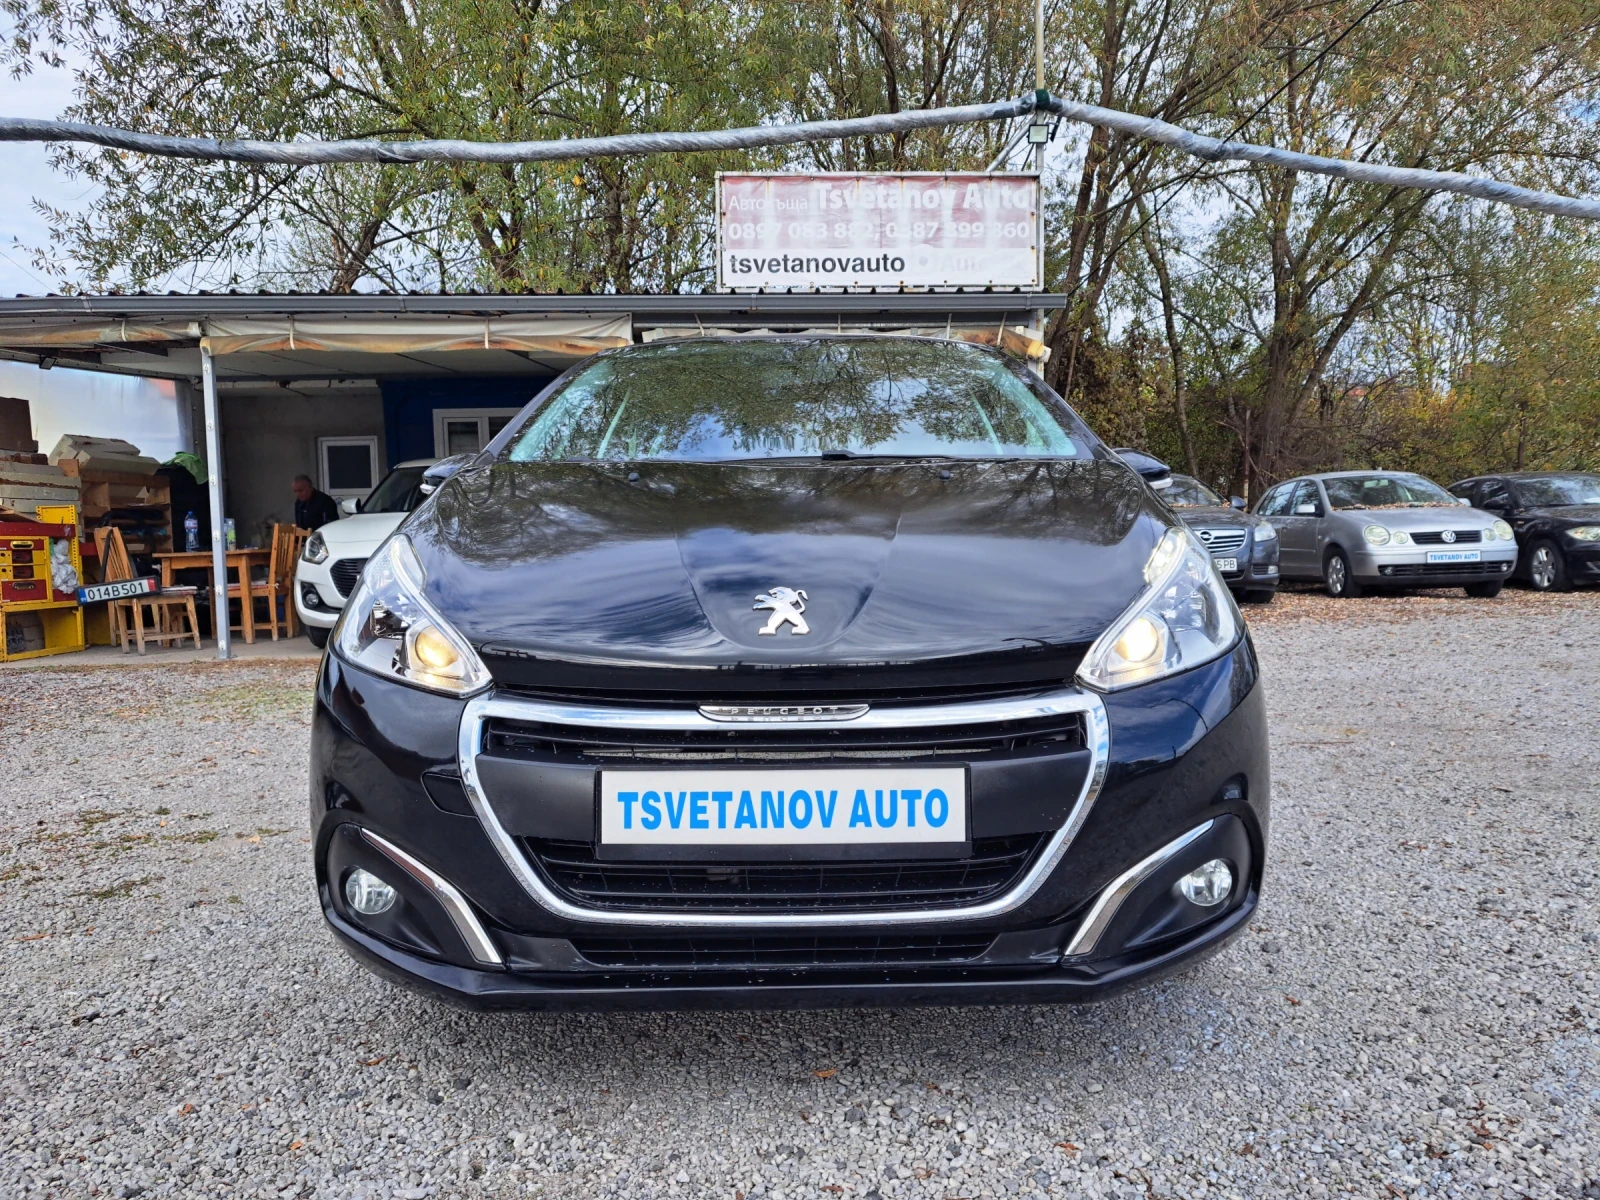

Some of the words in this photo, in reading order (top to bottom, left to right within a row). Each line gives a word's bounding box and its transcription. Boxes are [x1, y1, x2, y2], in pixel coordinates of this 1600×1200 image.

[728, 195, 808, 212] Автоъща
[814, 183, 957, 209] Tsvetanov
[962, 183, 1030, 209] Auto
[729, 253, 906, 274] tsvetanovauto
[87, 581, 145, 600] 014B501
[730, 707, 839, 716] PEUGEOT
[617, 790, 838, 831] TSVETANOV
[848, 788, 949, 829] AUTO
